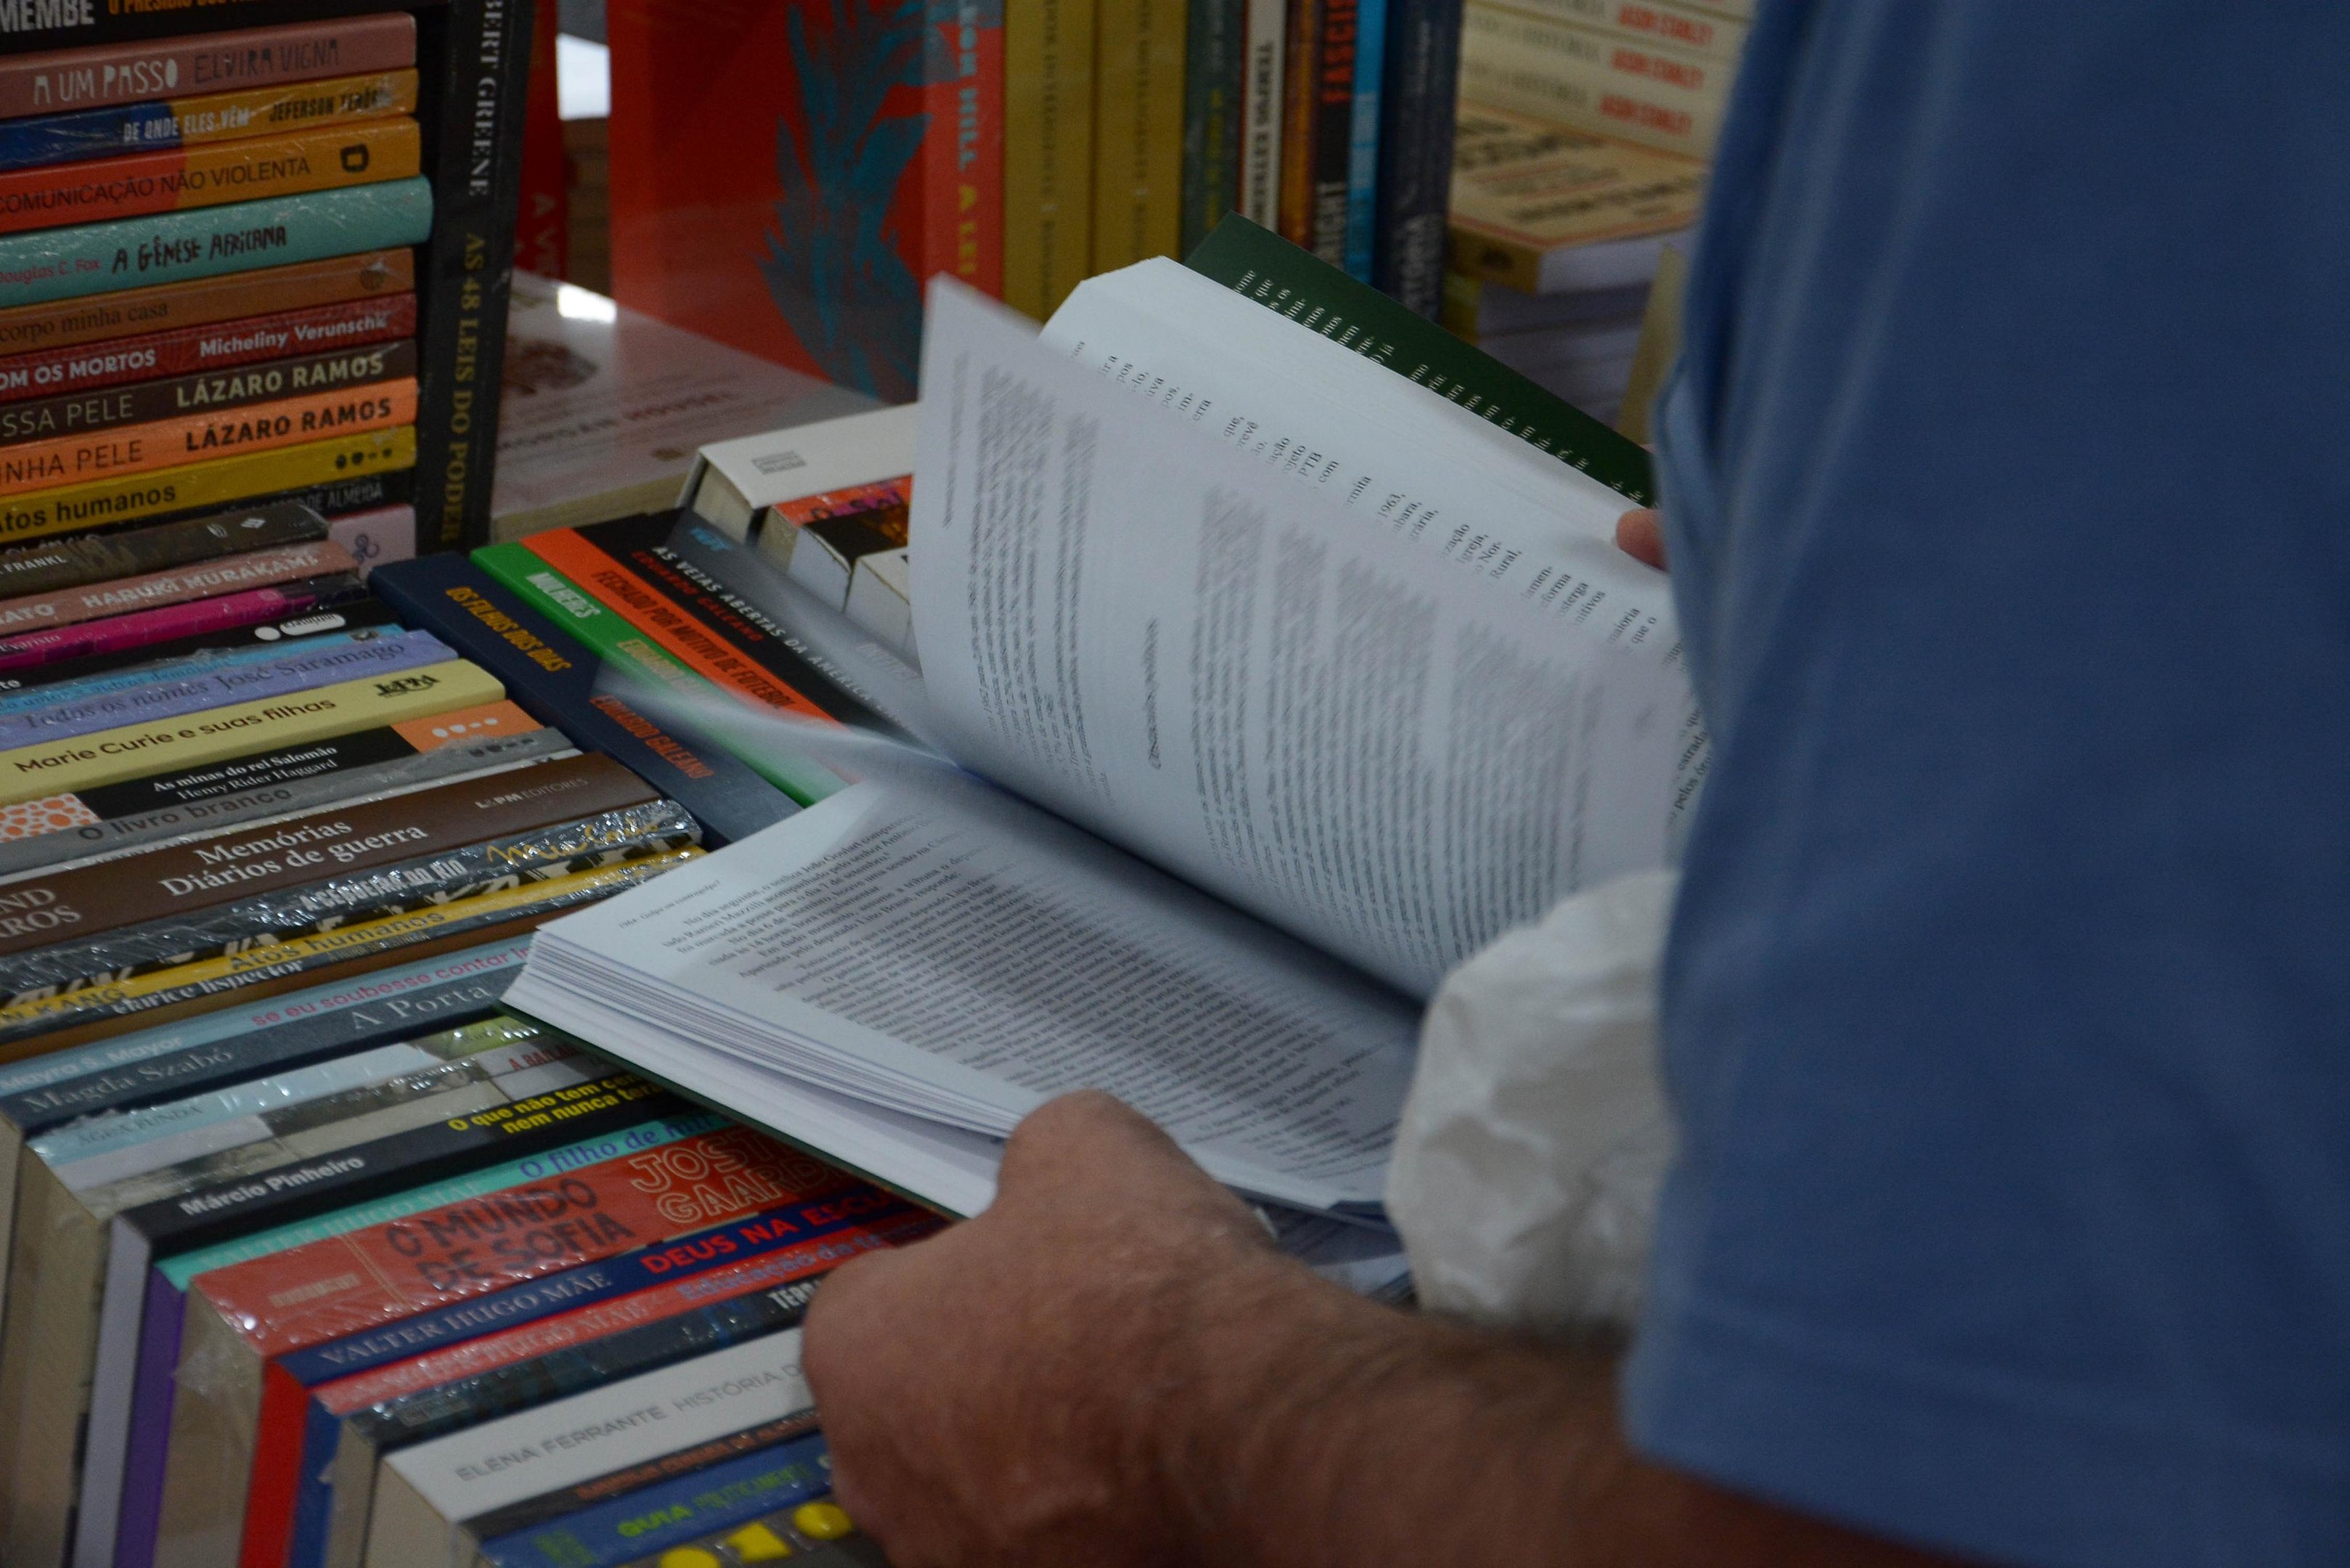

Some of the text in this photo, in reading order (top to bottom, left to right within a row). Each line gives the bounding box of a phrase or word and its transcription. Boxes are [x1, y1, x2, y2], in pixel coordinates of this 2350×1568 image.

[34, 38, 339, 105] A UM PASSO ELVIRA VIGNA
[124, 96, 334, 143] DE ONDE ELES VÊM JEFERSON
[468, 76, 498, 198] GREENE
[160, 171, 206, 195] NÃO
[211, 157, 311, 186] VIOLENTA
[76, 258, 100, 272] Fox
[113, 248, 128, 274] A
[0, 301, 168, 343] corpo minha casa
[35, 364, 63, 385] OS
[69, 349, 156, 379] MORTOS
[200, 332, 288, 359] Micheliny
[2, 352, 385, 438] SSA PELE LÁZARO RAMOS
[441, 232, 486, 543] AS 48 LEIS DO PODER
[5, 397, 392, 484] NHA PELE LÁZARO RAMOS
[1299, 451, 1323, 477] PTB
[1318, 459, 1339, 484] com
[57, 485, 176, 523] humanos
[1379, 491, 1406, 519] 1963,
[4, 554, 68, 574] FRANKL
[80, 576, 181, 609] HARUKI
[181, 548, 320, 591] MURAKAMI
[653, 546, 808, 654] AS VEIAS ABERTAS DA
[274, 643, 405, 676] Saramago
[526, 645, 573, 672] DIAS
[648, 601, 682, 628] POR
[671, 621, 727, 662] MOTIVO
[714, 653, 740, 676] DE
[731, 666, 796, 708] FUTEBOL
[15, 698, 336, 772] Marie Curie e suas filhas
[152, 746, 338, 793] As minas do rei Salomão
[176, 759, 338, 800] Henry Rider Haggard
[78, 787, 292, 841] O livro branco
[156, 822, 429, 898] Diários de guerra
[192, 820, 354, 866] Memórias
[0, 888, 57, 913] ND
[0, 905, 83, 939] ROS
[230, 945, 302, 972] Atos
[304, 911, 446, 951] humanos
[197, 960, 305, 993] lispector
[251, 1010, 282, 1026] se
[284, 1003, 319, 1018] eu
[321, 973, 433, 1009] soubesse
[435, 952, 511, 981] contar
[350, 984, 494, 1031] A Porta
[0, 1064, 80, 1088] Mayra
[107, 1036, 183, 1063] Mayor
[22, 1076, 137, 1111] Magda
[447, 1082, 605, 1132] O que não tem
[501, 1094, 620, 1135] nem nunca
[519, 1159, 546, 1179] O
[547, 1140, 619, 1174] filho
[623, 1127, 658, 1153] de
[179, 1157, 365, 1217] Márcio Pinheiro
[419, 1177, 598, 1249] MUNDO
[489, 1211, 637, 1270] SOFIA
[640, 1218, 801, 1275] DEUS NA
[320, 1319, 446, 1364] VALTER
[444, 1295, 540, 1331] HUGO
[453, 1443, 542, 1482] ELENA
[538, 1404, 669, 1453] FERRANTE
